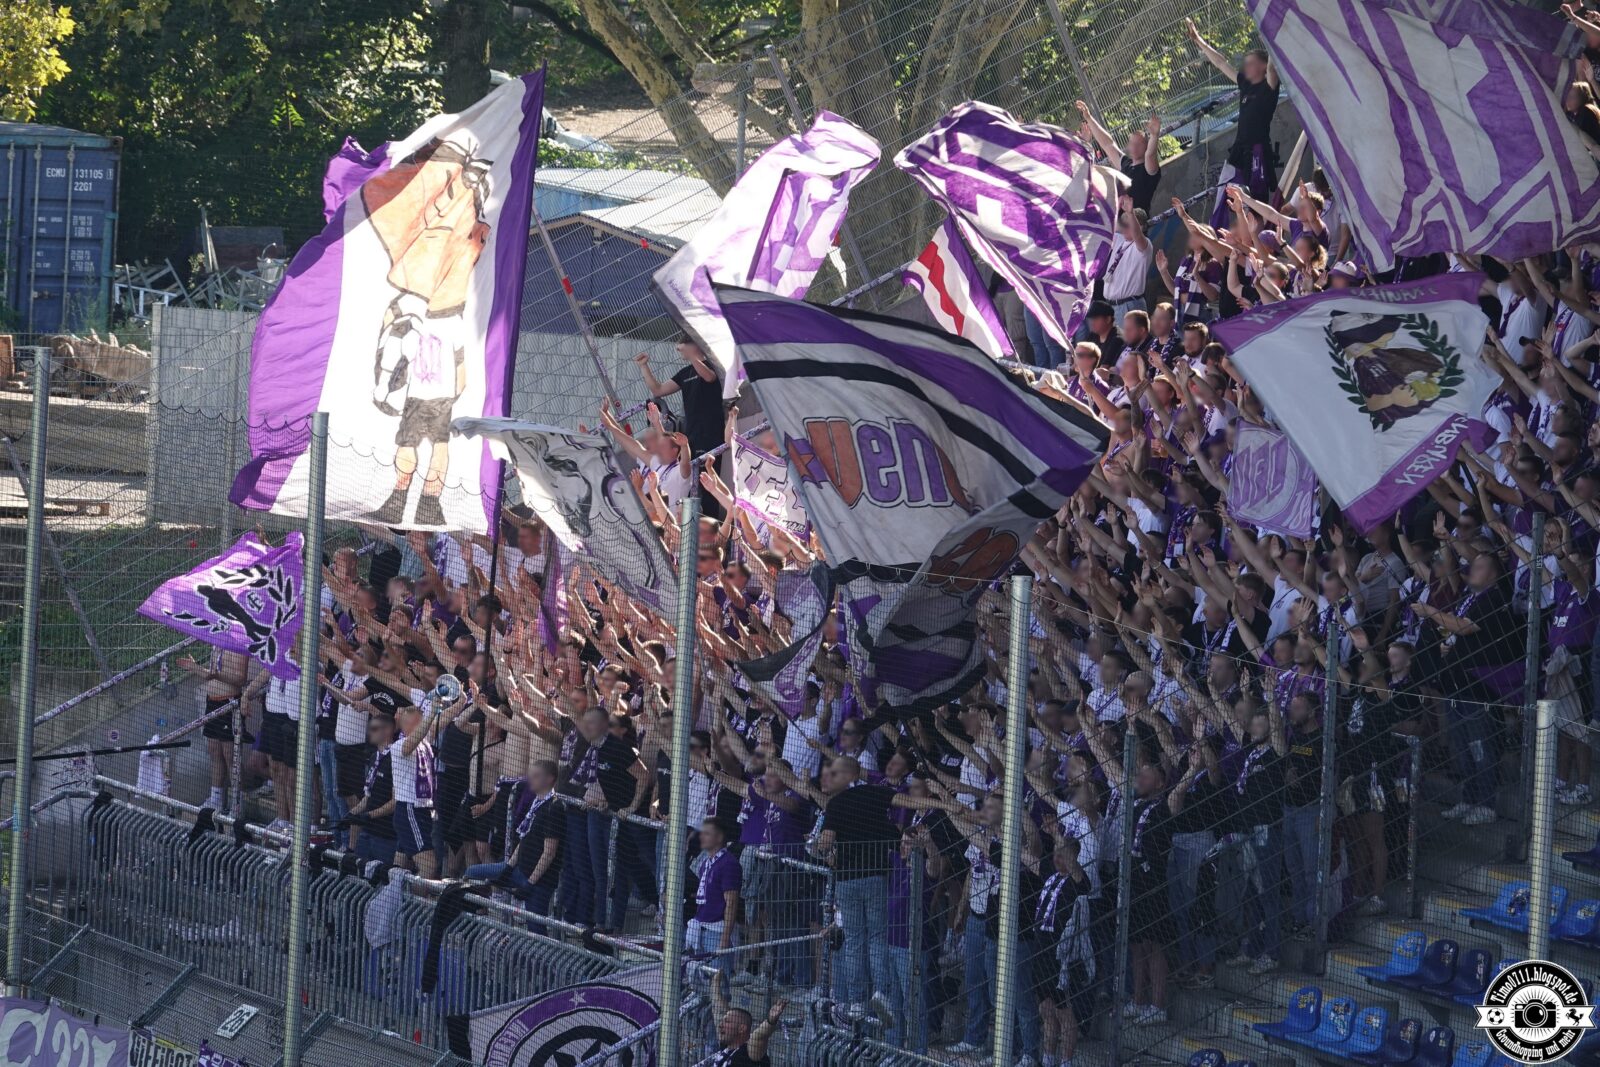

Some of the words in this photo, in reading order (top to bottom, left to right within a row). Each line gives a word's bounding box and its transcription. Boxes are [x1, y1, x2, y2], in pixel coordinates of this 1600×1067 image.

[46, 167, 66, 178] ECMU
[75, 168, 103, 179] 131105
[73, 181, 92, 192] 22G1
[223, 1008, 251, 1034] 26
